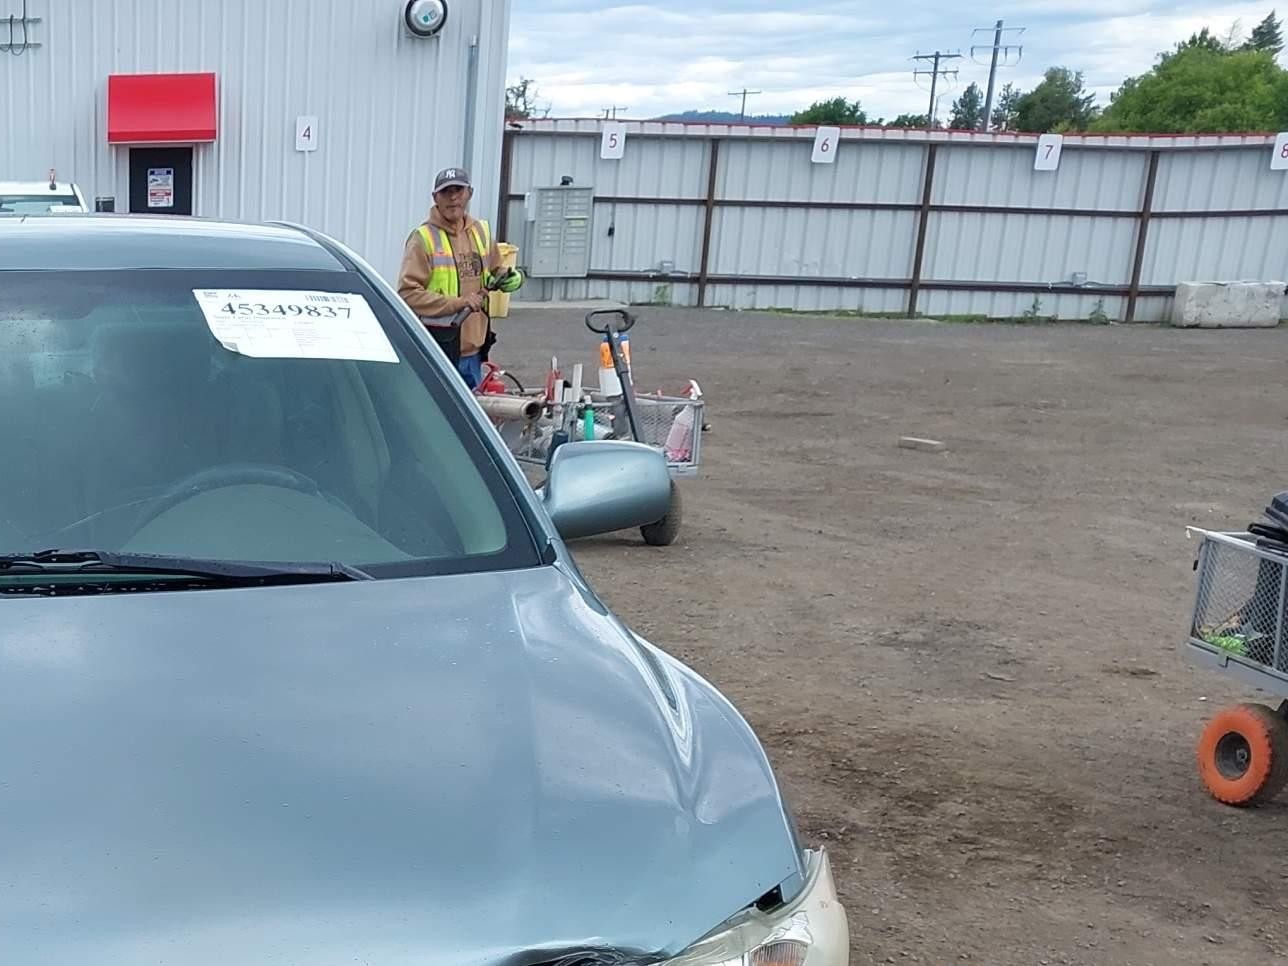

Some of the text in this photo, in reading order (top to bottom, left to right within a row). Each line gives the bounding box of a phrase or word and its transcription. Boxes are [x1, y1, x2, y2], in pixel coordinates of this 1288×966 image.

[302, 126, 311, 140] 4
[609, 133, 617, 148] 5
[820, 138, 830, 152] 6
[1044, 144, 1053, 160] 7
[1280, 143, 1288, 158] 8
[221, 301, 352, 319] 45349837
